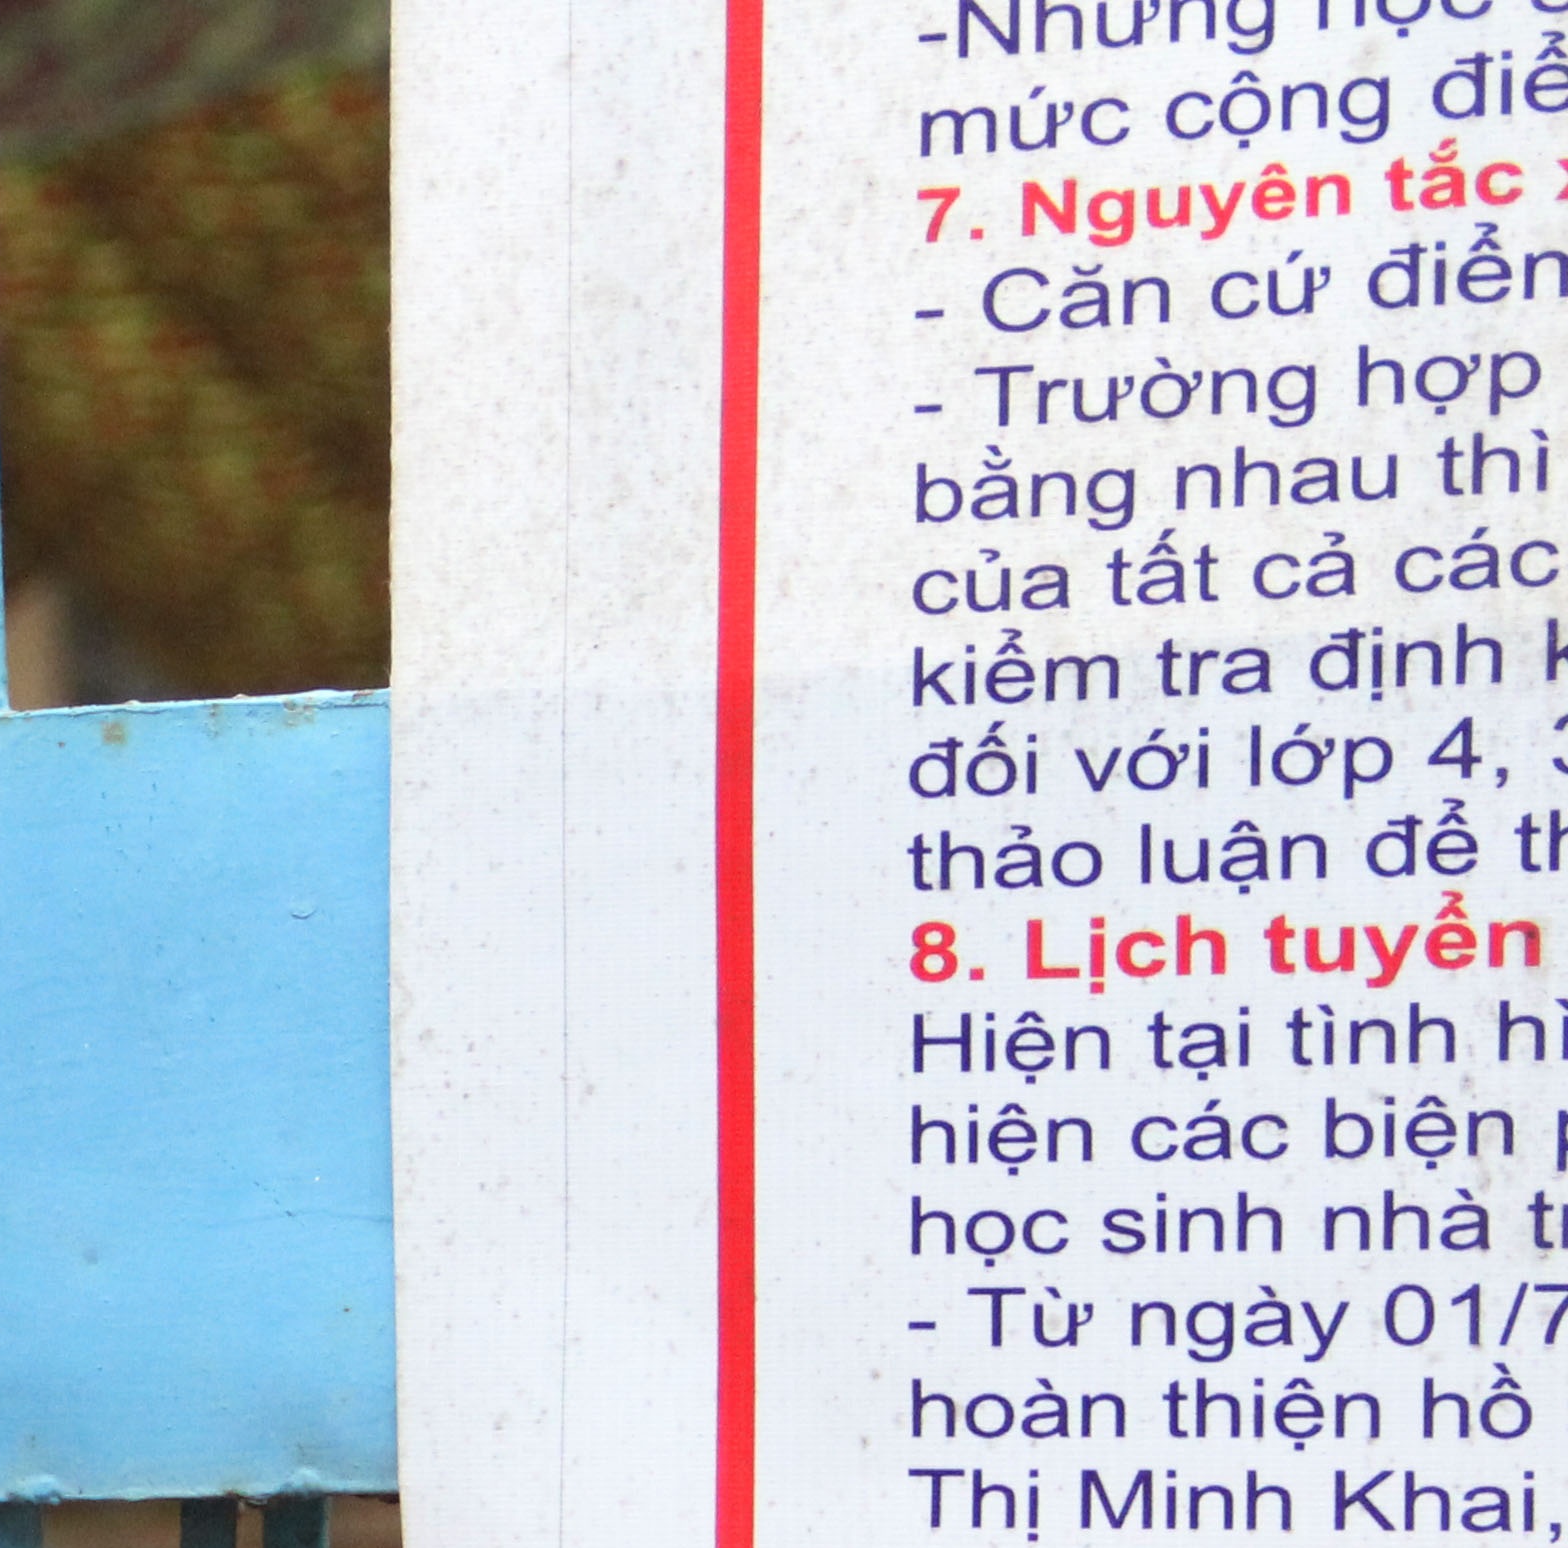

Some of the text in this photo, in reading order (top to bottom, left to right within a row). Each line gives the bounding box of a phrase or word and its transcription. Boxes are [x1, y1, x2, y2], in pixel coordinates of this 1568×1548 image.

[920, 86, 1130, 157] mức
[1166, 70, 1390, 149] cộng
[917, 188, 983, 243] 7.
[1022, 163, 1351, 247] Nguyên
[1384, 138, 1522, 211] tắc
[983, 264, 1170, 333] Căn
[1211, 250, 1331, 320] cứ
[974, 357, 1316, 428] Trường
[1358, 344, 1541, 416] hợp
[916, 429, 1549, 531] bằng nhau thì
[913, 526, 1559, 615] của tất cả các
[913, 628, 1120, 707] kiểm
[1156, 638, 1272, 697] tra
[1309, 622, 1503, 702] định
[909, 720, 1037, 799] đối
[1074, 726, 1209, 792] với
[1250, 723, 1393, 800] lớp
[1427, 716, 1508, 789] 4,
[907, 824, 1103, 891] thảo
[1141, 820, 1327, 895] luận
[1366, 797, 1478, 878] để
[909, 890, 1541, 994] 8. Lịch tuyển
[913, 1010, 1110, 1085] Hiện
[1147, 1006, 1250, 1081] tại
[1286, 1002, 1456, 1067] tình
[911, 1102, 1093, 1176] hiện
[1131, 1099, 1289, 1162] các
[1325, 1095, 1514, 1170] biện
[911, 1188, 1568, 1268] học sinh nhà t
[967, 1286, 1094, 1348] Từ
[1131, 1285, 1350, 1363] ngày
[1384, 1282, 1568, 1347] 01/7
[911, 1362, 1533, 1451] hoàn thiện hồ
[908, 1468, 1561, 1543] Thị Minh Khai,
